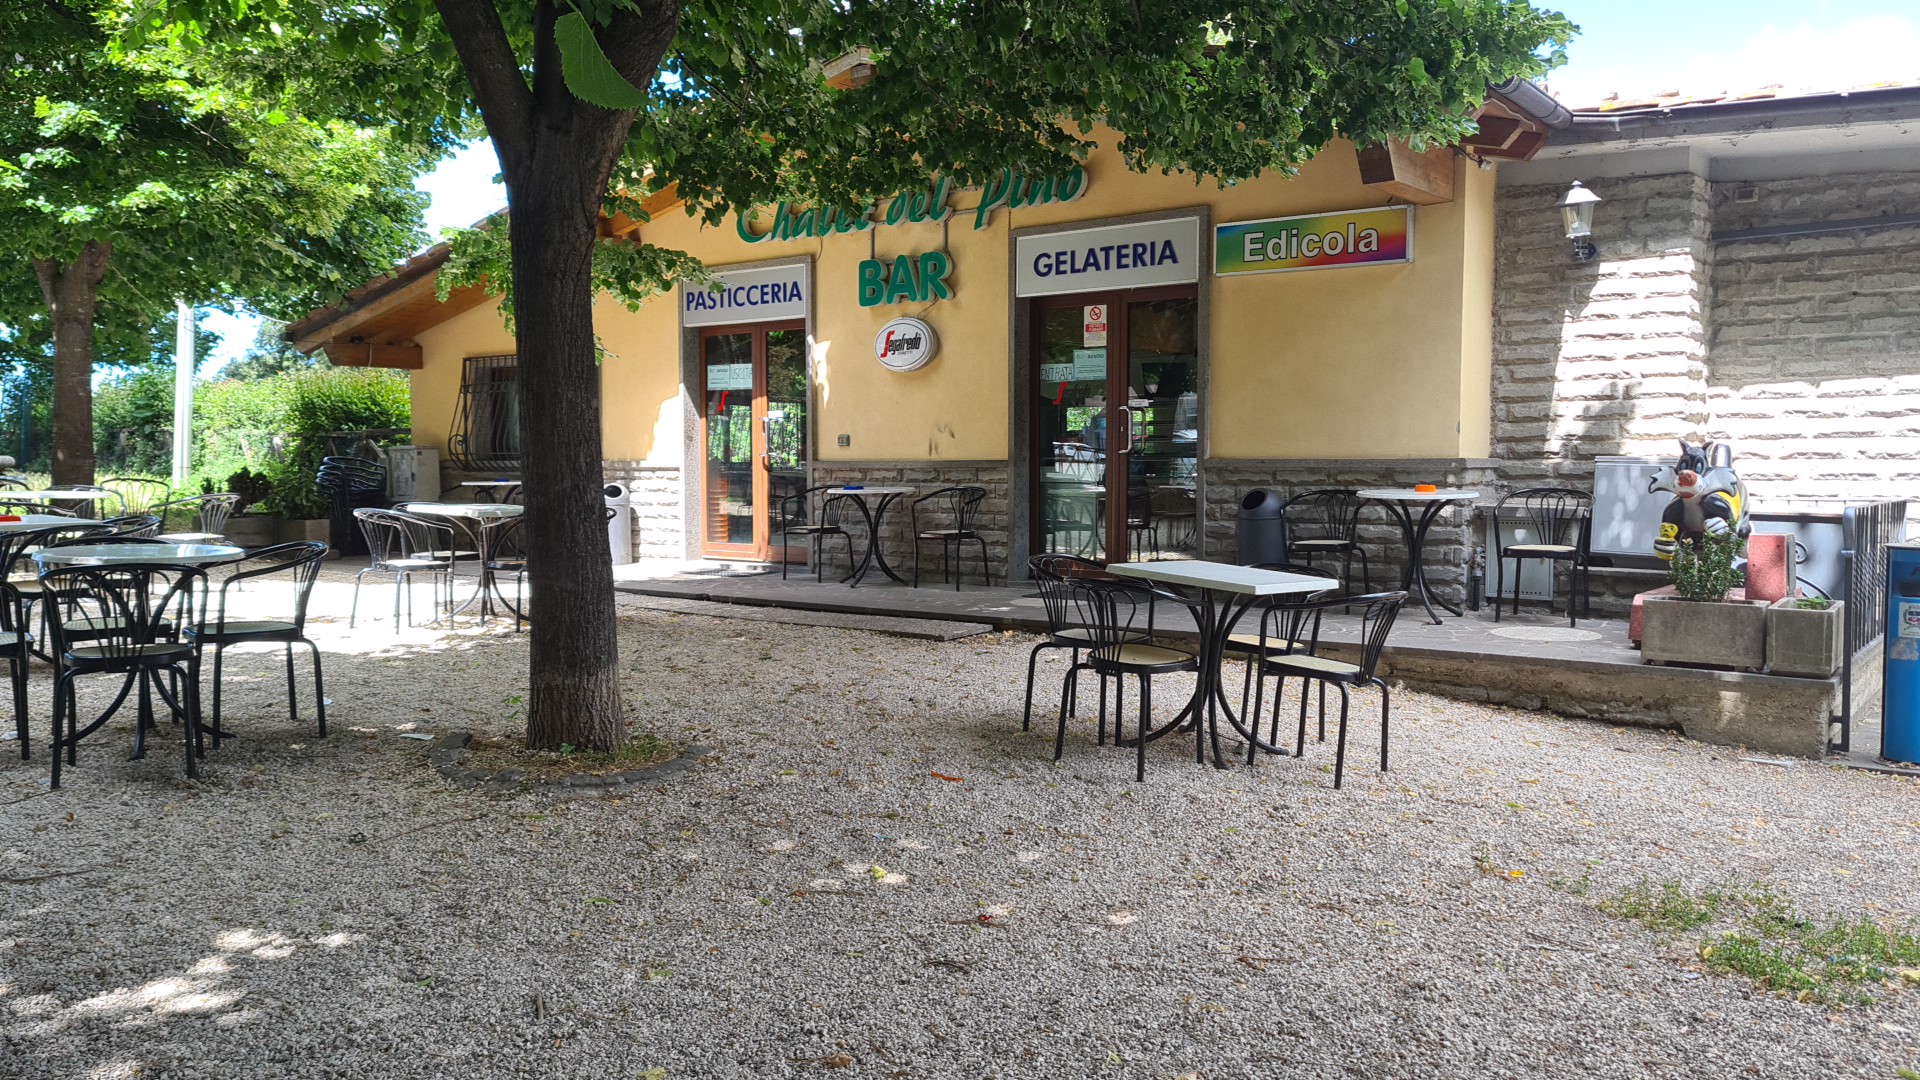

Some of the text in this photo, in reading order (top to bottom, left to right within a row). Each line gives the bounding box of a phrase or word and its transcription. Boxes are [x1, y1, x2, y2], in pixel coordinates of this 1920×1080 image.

[1033, 240, 1178, 277] GELATERIA
[1243, 223, 1379, 263] Edicola
[686, 280, 803, 312] PASTICCERIA
[858, 251, 949, 307] BAR
[880, 330, 922, 358] Segafredo
[1041, 366, 1073, 380] ENTRATA
